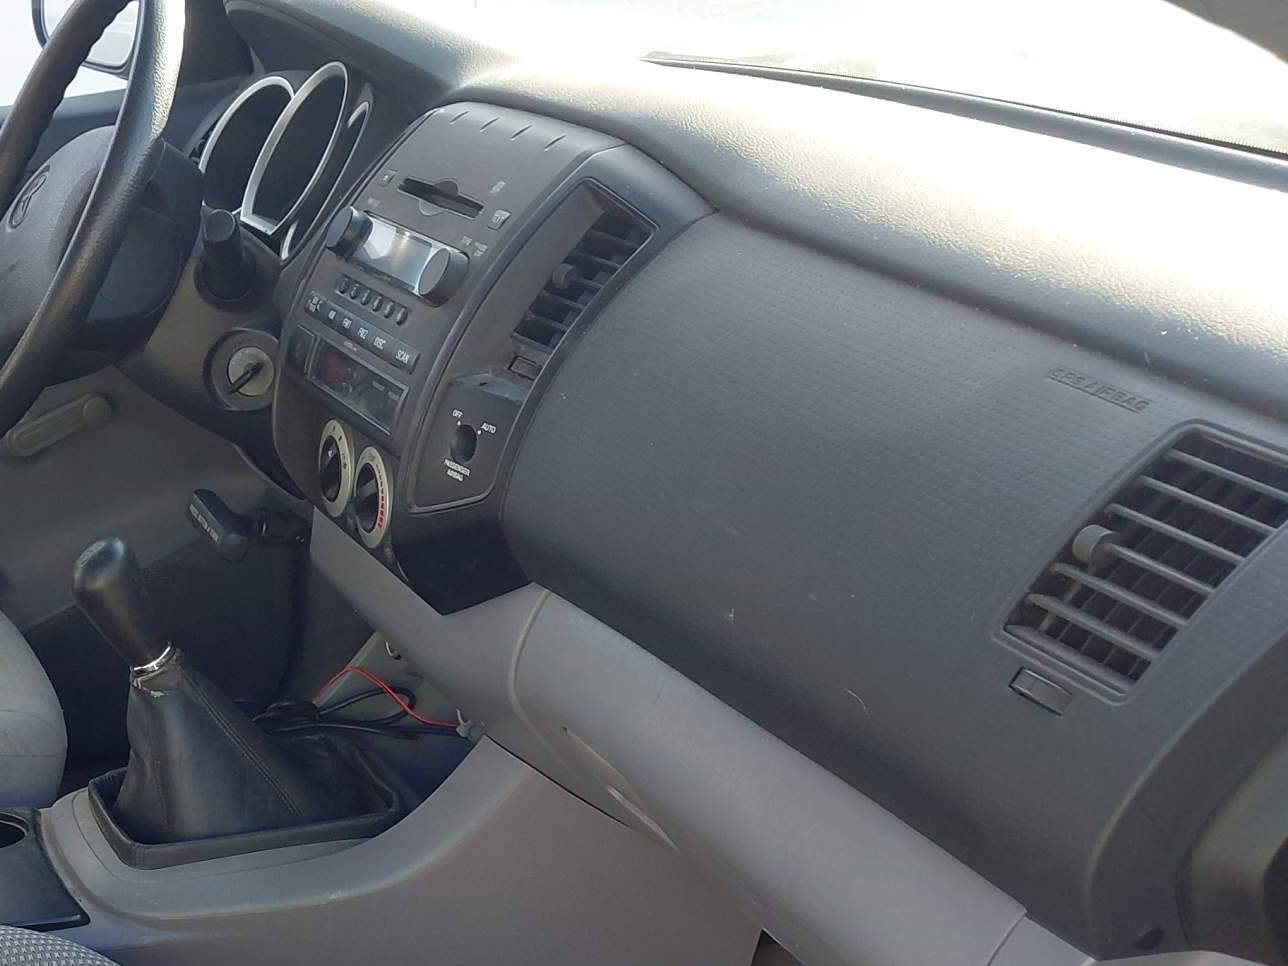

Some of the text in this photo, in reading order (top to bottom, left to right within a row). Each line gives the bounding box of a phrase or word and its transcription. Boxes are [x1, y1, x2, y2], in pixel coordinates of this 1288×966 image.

[373, 336, 387, 351] DISC
[395, 349, 410, 364] SCAN
[1083, 381, 1150, 411] AIRBAG
[480, 422, 497, 434] AUTO
